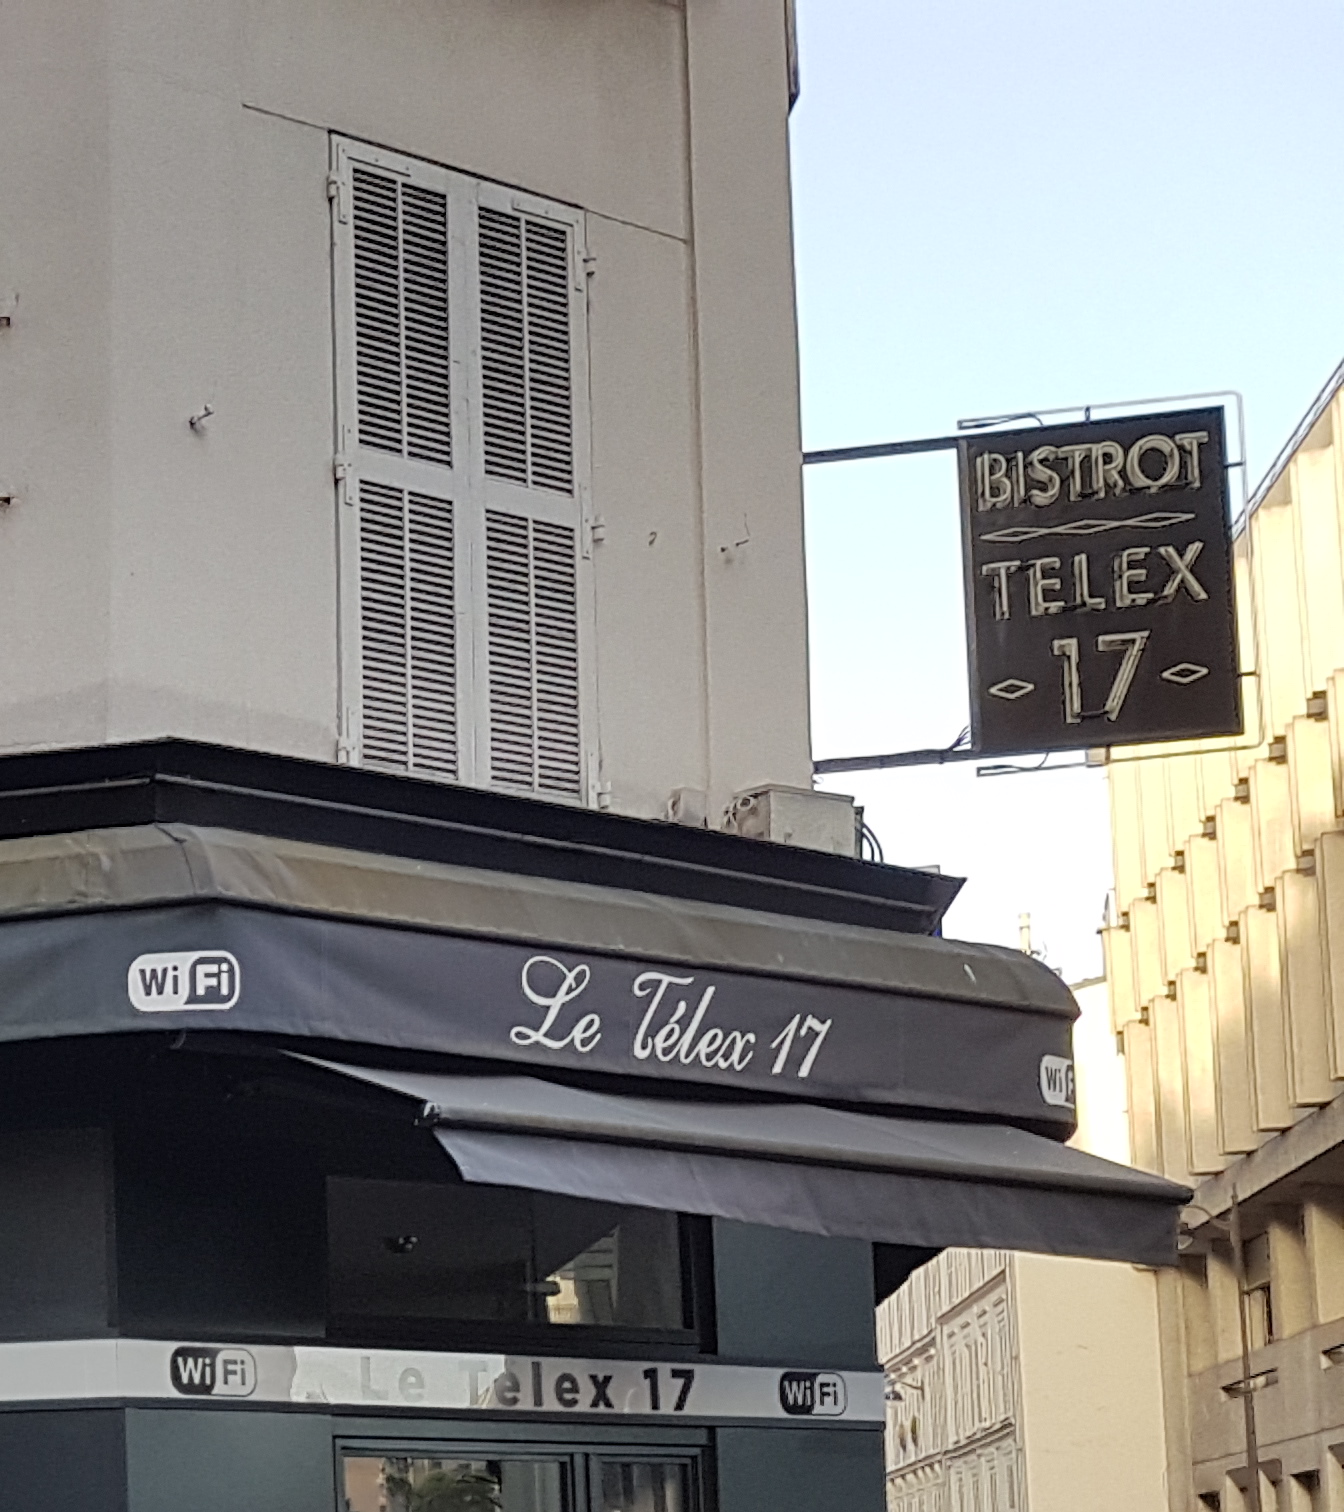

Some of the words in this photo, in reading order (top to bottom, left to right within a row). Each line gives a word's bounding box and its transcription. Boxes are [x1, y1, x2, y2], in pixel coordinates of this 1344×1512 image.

[975, 431, 1210, 512] BISTROT
[981, 540, 1210, 621] TELEX
[1052, 630, 1152, 724] 17
[509, 955, 602, 1054] Le
[632, 971, 756, 1073] Télex
[767, 1013, 833, 1080] 17
[360, 1355, 427, 1403] Le
[459, 1354, 616, 1410] Telex
[642, 1366, 696, 1413] 17
